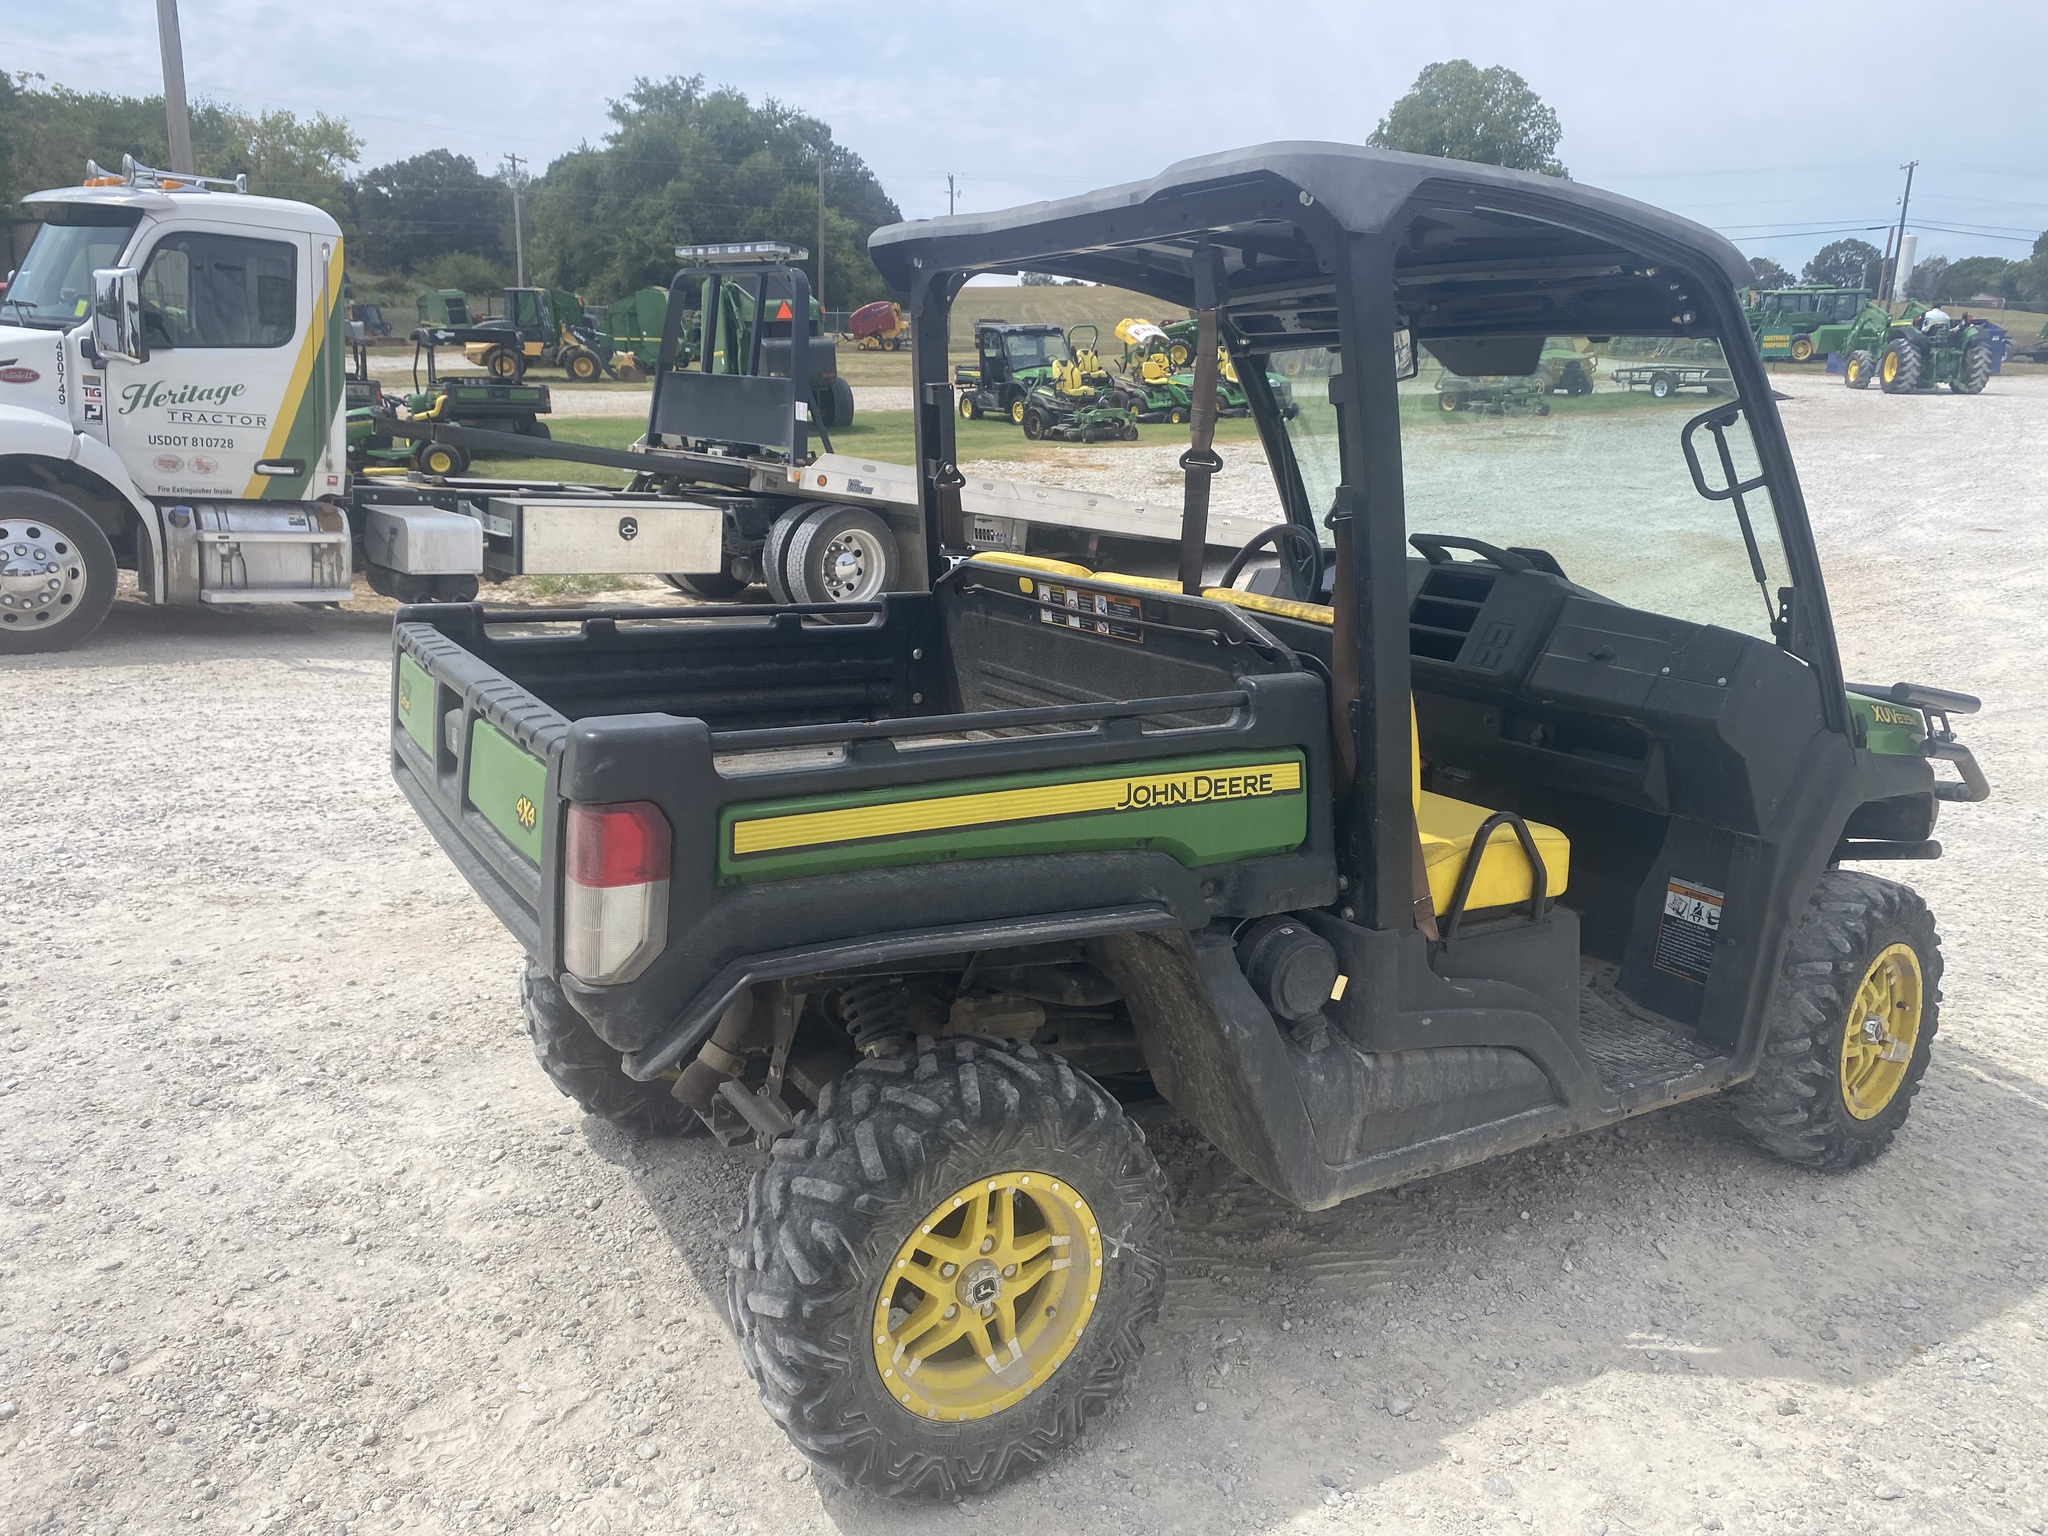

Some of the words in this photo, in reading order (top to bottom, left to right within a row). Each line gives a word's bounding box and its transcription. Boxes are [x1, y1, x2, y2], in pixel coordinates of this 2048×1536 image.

[56, 340, 66, 405] 480749
[118, 379, 247, 415] Heritage
[167, 411, 267, 427] TRACTOR
[148, 434, 188, 447] USDOT
[191, 437, 234, 449] 810728
[157, 485, 171, 493] Fire
[172, 486, 212, 495] Extinguisher
[1117, 781, 1188, 808] JOHN
[1193, 773, 1274, 799] DEERE
